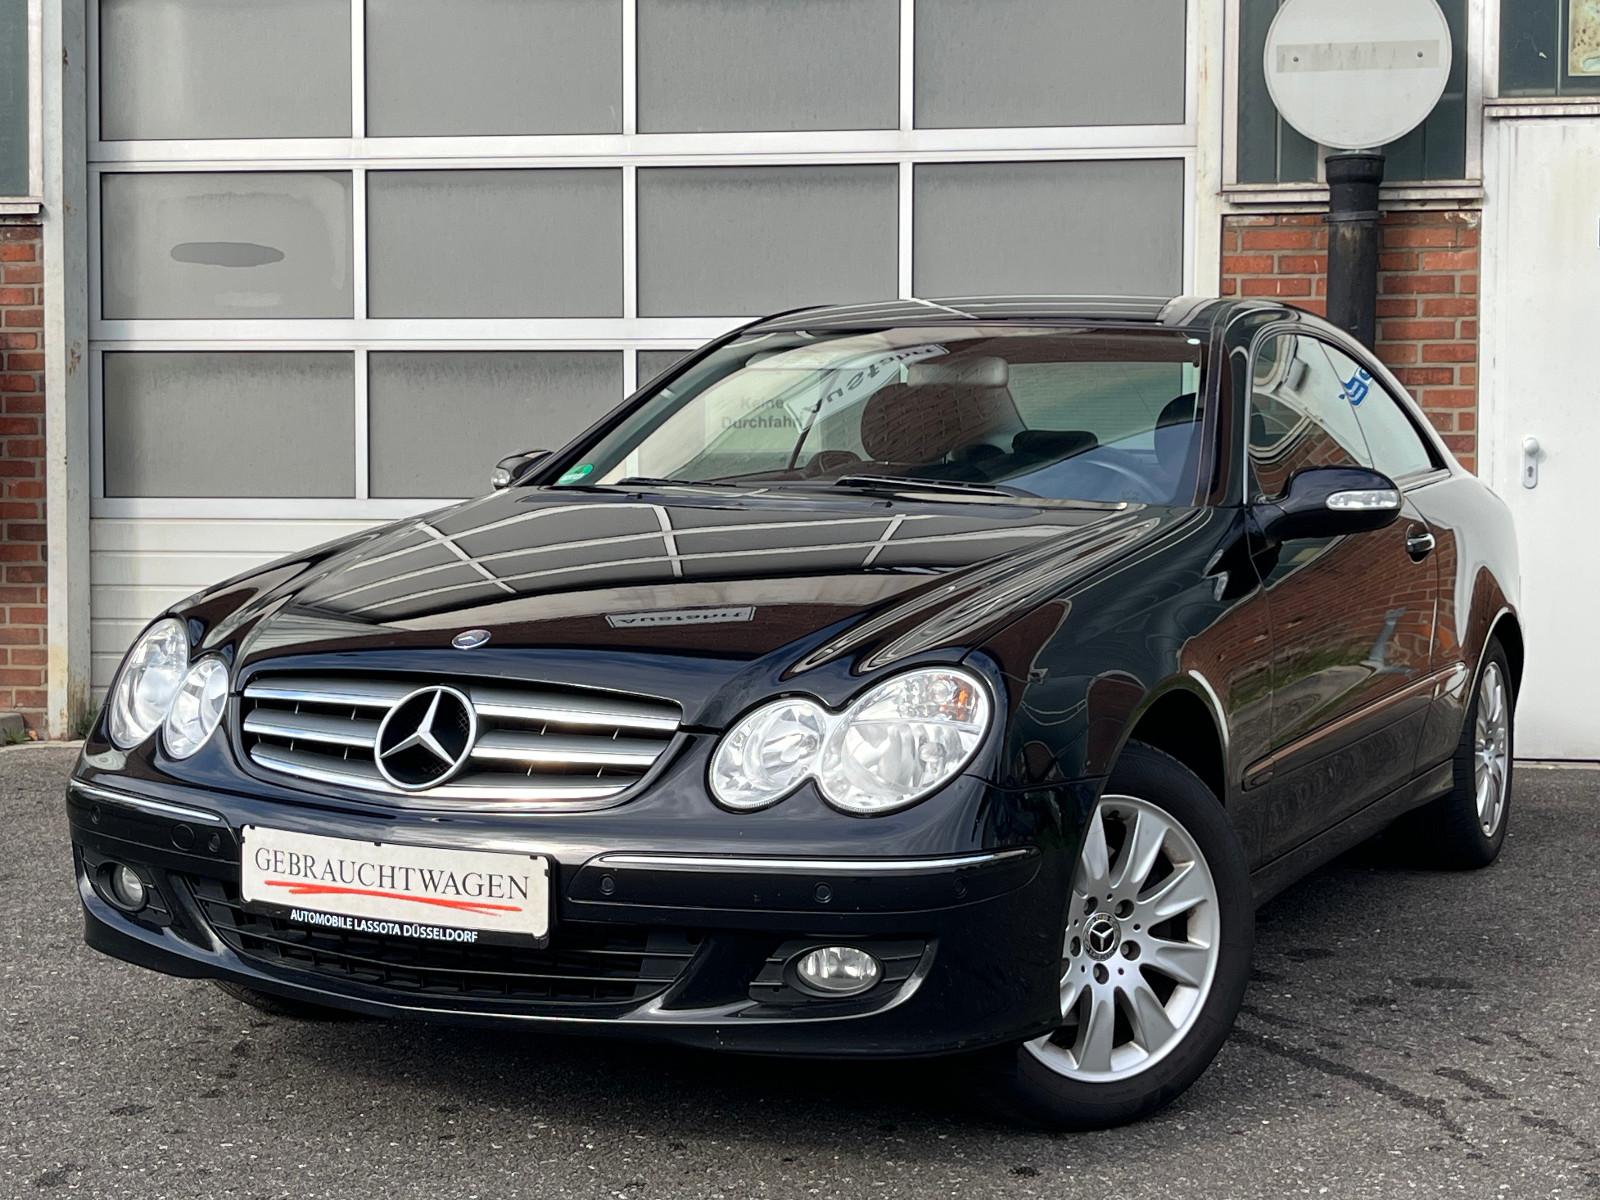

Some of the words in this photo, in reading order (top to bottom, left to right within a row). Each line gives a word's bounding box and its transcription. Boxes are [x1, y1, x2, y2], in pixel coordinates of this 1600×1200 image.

[740, 396, 784, 409] Keine
[721, 415, 797, 429] Durchfah
[254, 847, 530, 900] GEBRAUCHTWAGEN
[290, 908, 353, 930] AUTOMOBILE
[354, 918, 401, 936] LASSOTA
[403, 923, 478, 943] DÜSSELDORF
